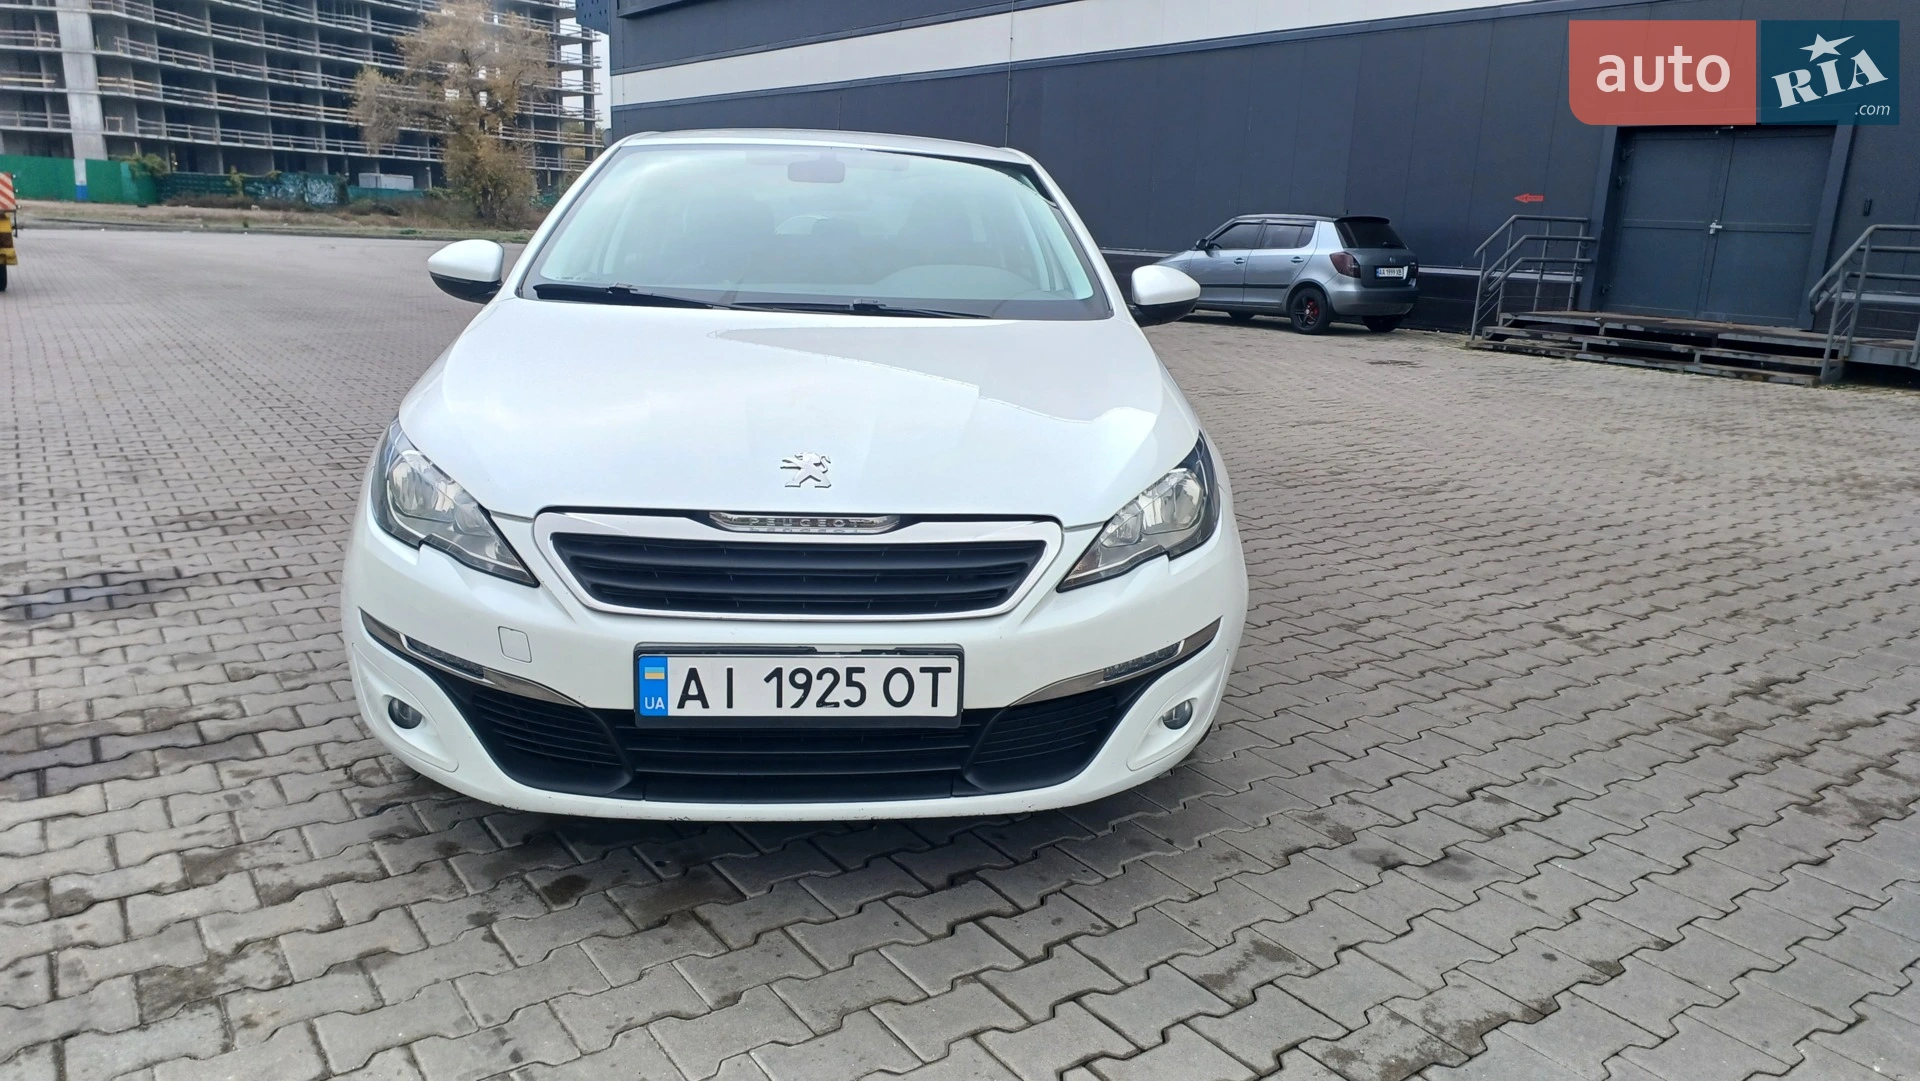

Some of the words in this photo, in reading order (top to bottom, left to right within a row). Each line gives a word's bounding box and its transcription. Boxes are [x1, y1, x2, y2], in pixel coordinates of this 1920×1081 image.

[750, 517, 859, 527] PEUGEOT
[676, 667, 734, 709] AI
[763, 666, 867, 709] 1925
[882, 666, 952, 708] OT
[644, 696, 665, 710] UA
